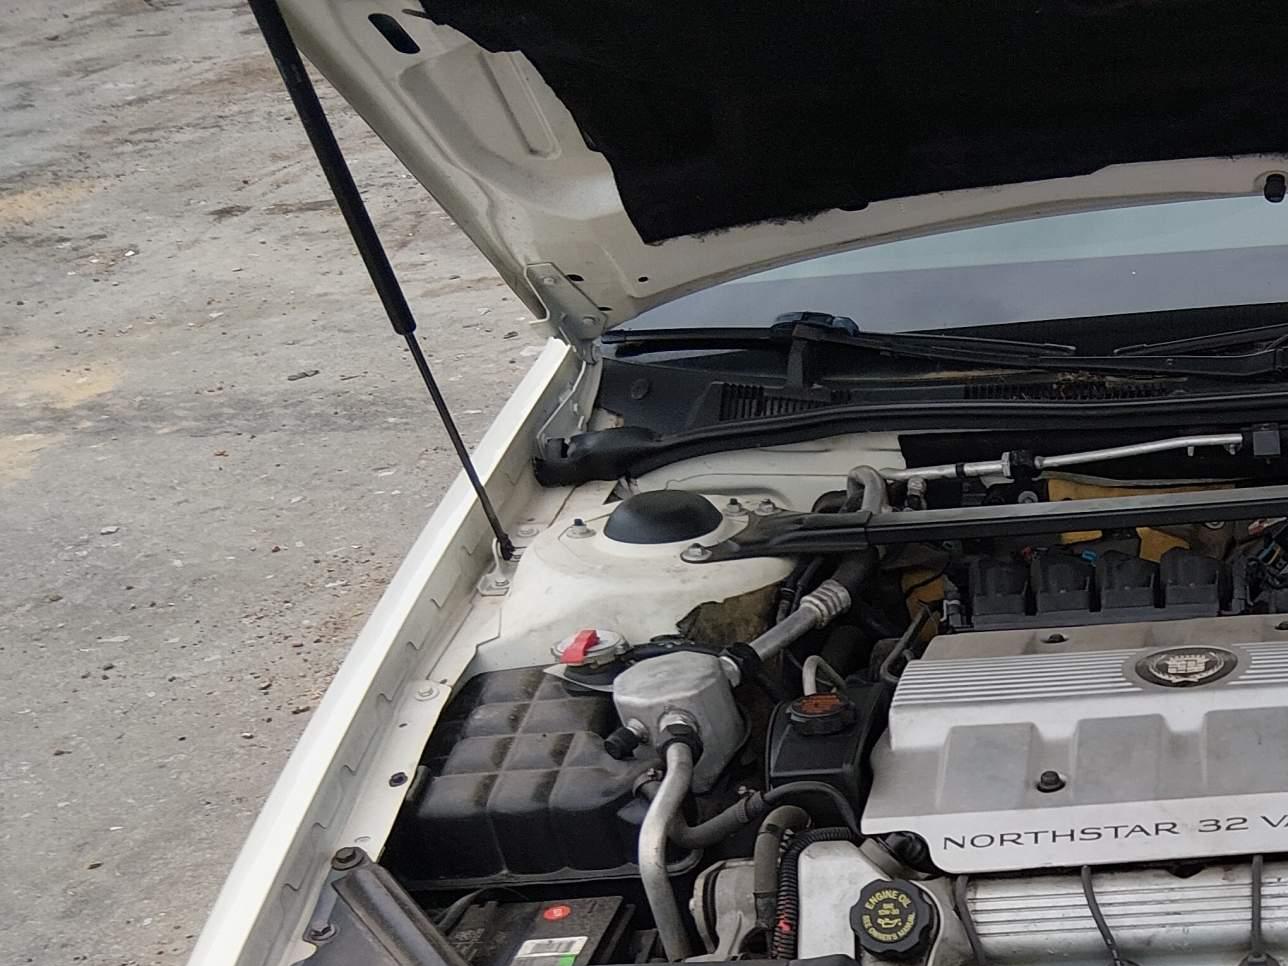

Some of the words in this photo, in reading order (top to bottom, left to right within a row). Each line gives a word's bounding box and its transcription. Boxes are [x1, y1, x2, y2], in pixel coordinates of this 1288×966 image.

[943, 821, 1180, 850] NORTHSTAR
[1198, 816, 1250, 833] 32
[864, 890, 899, 910] ENGINE
[898, 894, 912, 908] OIL
